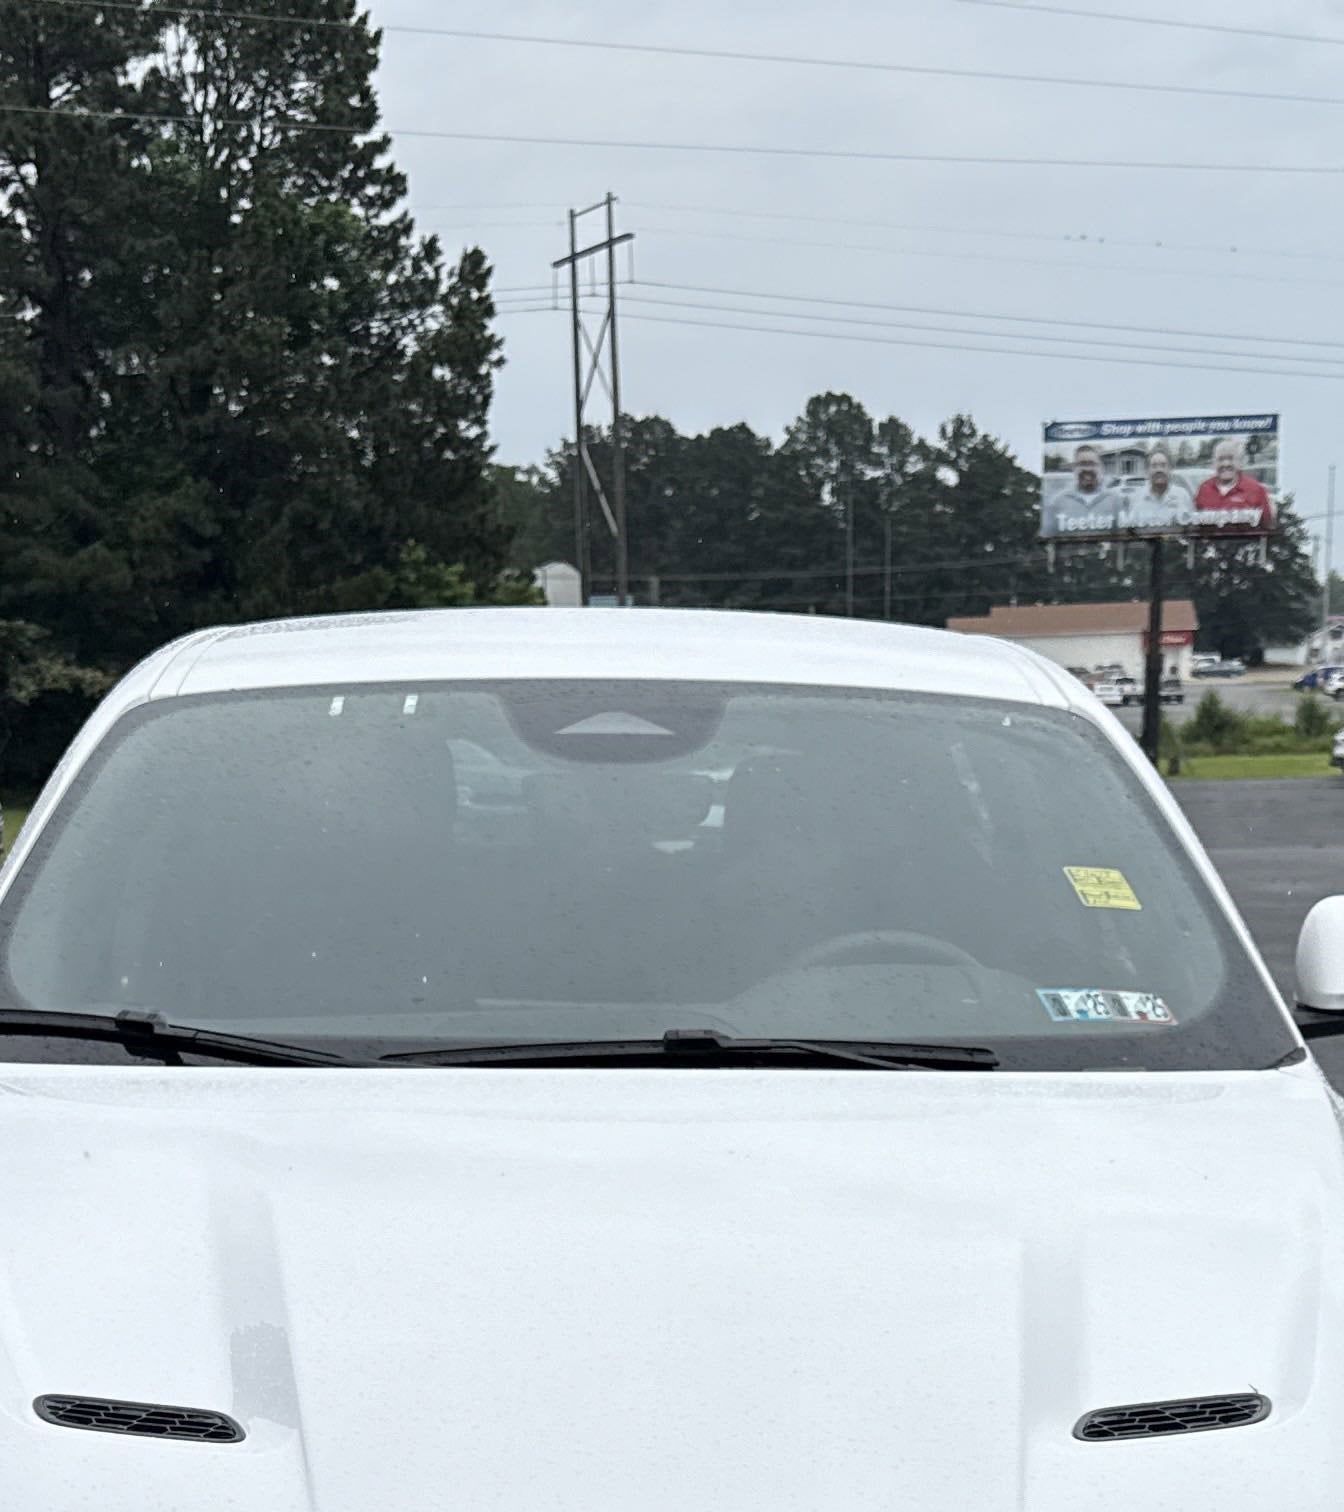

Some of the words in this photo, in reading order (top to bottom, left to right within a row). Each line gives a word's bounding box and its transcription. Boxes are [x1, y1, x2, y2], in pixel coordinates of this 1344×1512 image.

[1101, 422, 1132, 437] Shop
[1135, 421, 1162, 433] with
[1164, 420, 1207, 435] people
[1209, 420, 1230, 434] you
[1231, 417, 1274, 431] know!
[1056, 513, 1114, 531] Teeter
[1177, 508, 1265, 528] Company
